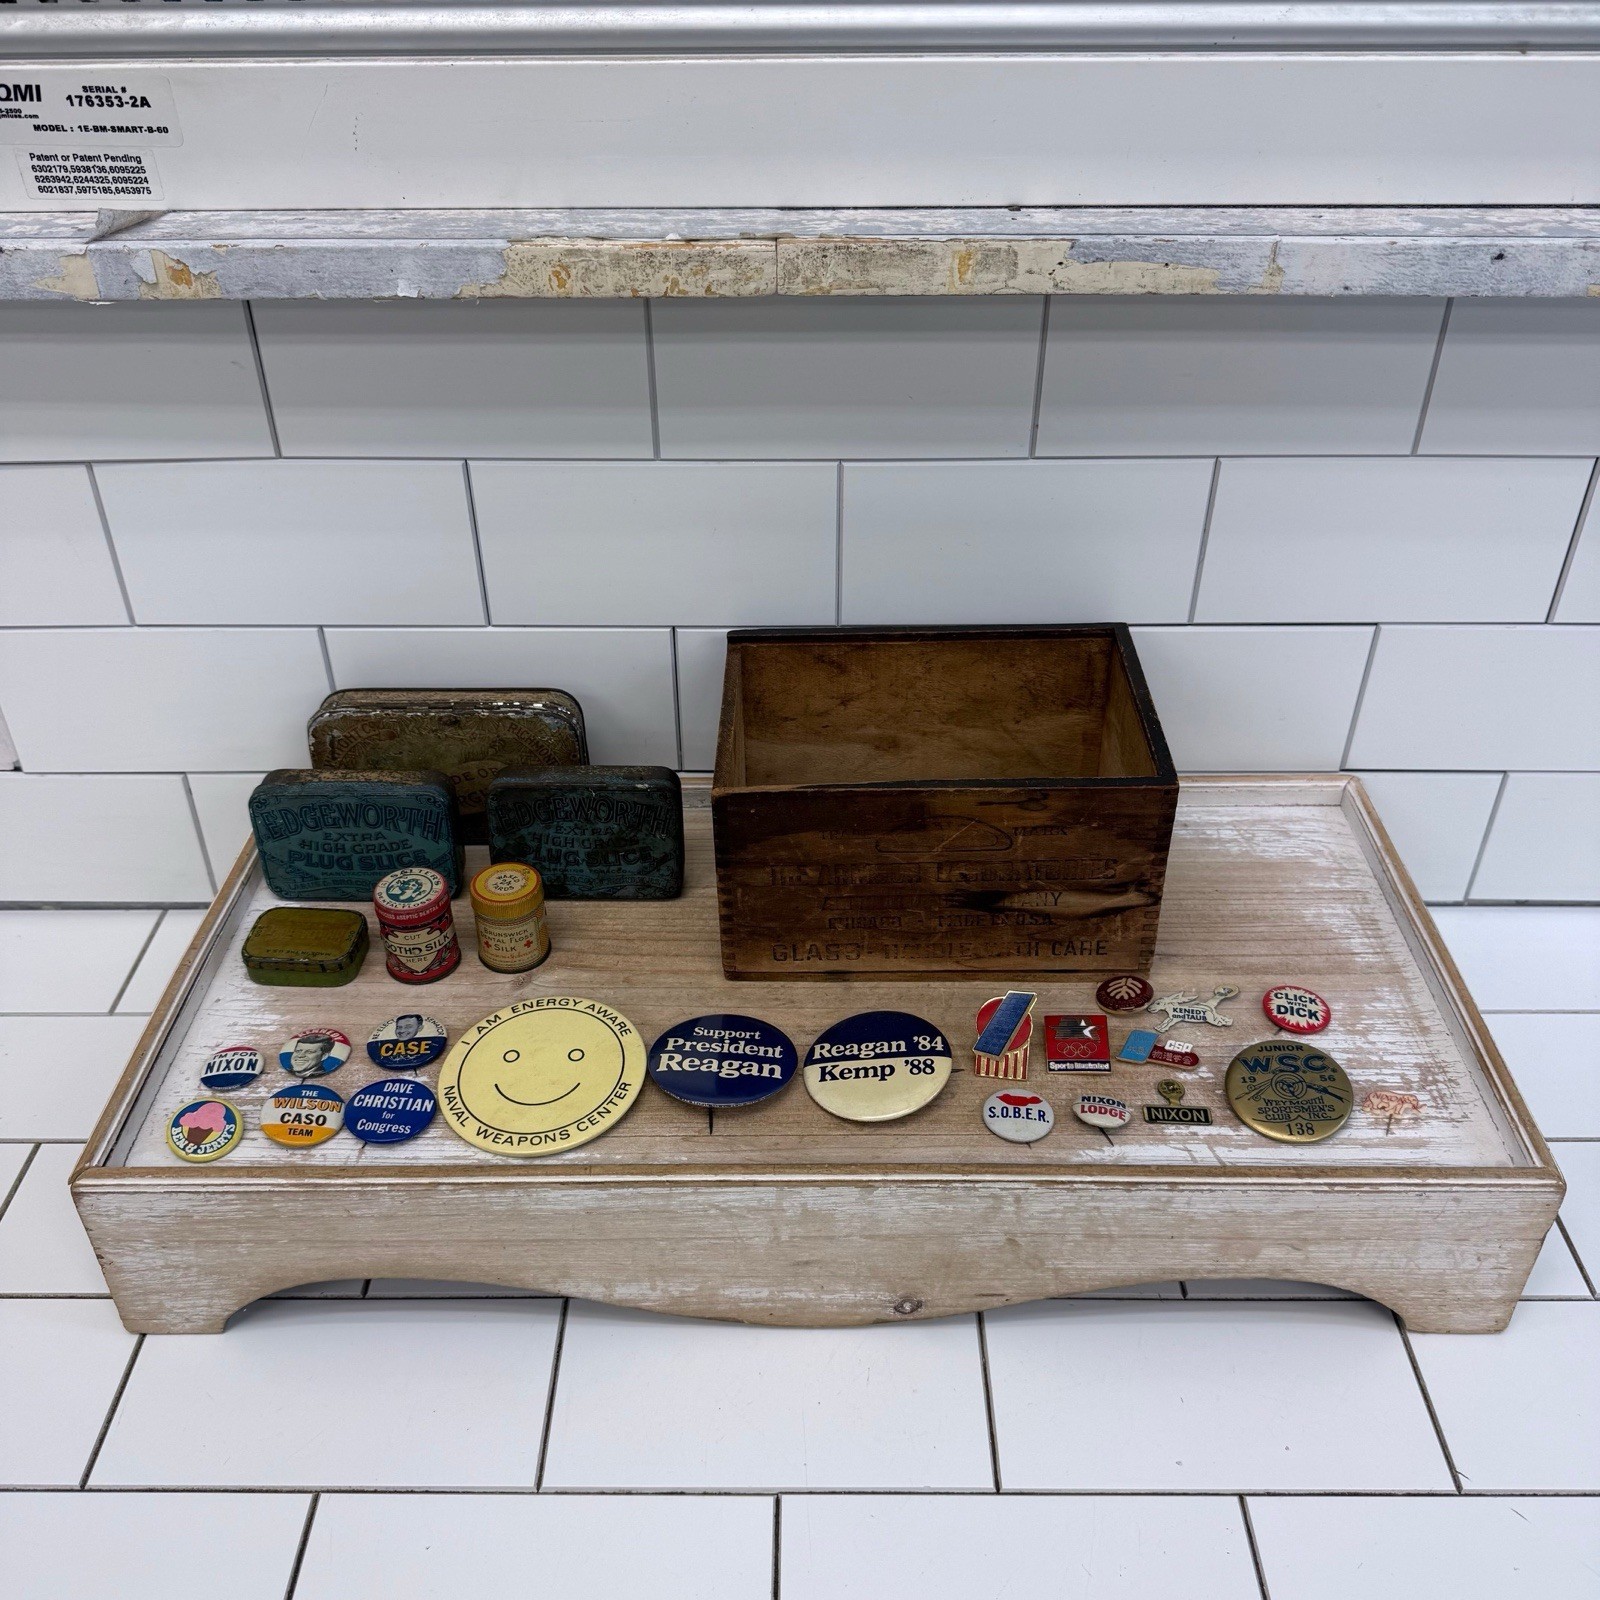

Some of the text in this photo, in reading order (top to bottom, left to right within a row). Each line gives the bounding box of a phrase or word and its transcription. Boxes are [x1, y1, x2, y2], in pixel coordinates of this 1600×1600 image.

[0, 84, 42, 102] QMI
[82, 85, 118, 94] SERIAL
[65, 94, 152, 108] 176353-2A
[33, 124, 68, 132] MODEL
[77, 125, 169, 134] 1E-BM-SMART-B-60
[29, 153, 59, 162] Patent
[72, 153, 102, 162] Patent
[104, 153, 142, 165] Pending
[508, 722, 562, 767] RICHMON
[260, 802, 444, 844] EDGEWORTH
[497, 795, 671, 836] EDGEWORTH
[322, 832, 387, 842] EXTRA
[555, 826, 616, 836] EXTRA
[300, 838, 413, 855] HIGH GRADE
[531, 833, 575, 848] HIGH
[288, 849, 432, 870] PLUG SLICE
[585, 846, 655, 867] SLICE
[384, 932, 450, 955] OOTH SILK
[772, 942, 861, 962] GLASS
[1051, 940, 1109, 957] CARE
[1273, 992, 1319, 1006] CLICK
[1286, 1000, 1308, 1008] WITH
[476, 1014, 502, 1035] AM
[510, 998, 583, 1014] ENERGY
[584, 1003, 633, 1037] AWARE
[1172, 1007, 1207, 1015] KENEDY
[1276, 1004, 1320, 1022] DICK
[425, 1016, 445, 1036] SENATOR
[693, 1026, 761, 1040] Support
[381, 1040, 432, 1057] CASE
[664, 1037, 783, 1059] President
[812, 1035, 944, 1060] Reagan '84
[1164, 1040, 1193, 1053] CSP
[204, 1057, 259, 1075] NIXON
[656, 1053, 783, 1079] Reagan
[818, 1058, 935, 1082] Kemp '88
[1049, 1061, 1074, 1070] Sports
[1319, 1074, 1336, 1082] 56
[301, 1089, 319, 1097] THE
[383, 1082, 415, 1094] DAVE
[273, 1097, 342, 1113] WILSON
[353, 1094, 434, 1112] CHRISTIAN
[1081, 1095, 1126, 1110] NIXON
[1257, 1104, 1336, 1114] SPORTSMEN'S
[1263, 1096, 1325, 1106] WEYMOUTH
[280, 1112, 327, 1126] CASO
[381, 1110, 396, 1119] for
[443, 1085, 472, 1128] NAVAL
[475, 1125, 571, 1146] WEAPONS
[576, 1081, 632, 1132] CENTER
[988, 1106, 1050, 1124] S.O.B.E.R.
[1080, 1104, 1126, 1122] LODGE
[1151, 1108, 1206, 1122] NIXON
[288, 1127, 313, 1137] TEAM
[357, 1118, 411, 1135] Congress
[1285, 1122, 1315, 1136] 138
[171, 1123, 235, 1154] BEN & JERRY'S
